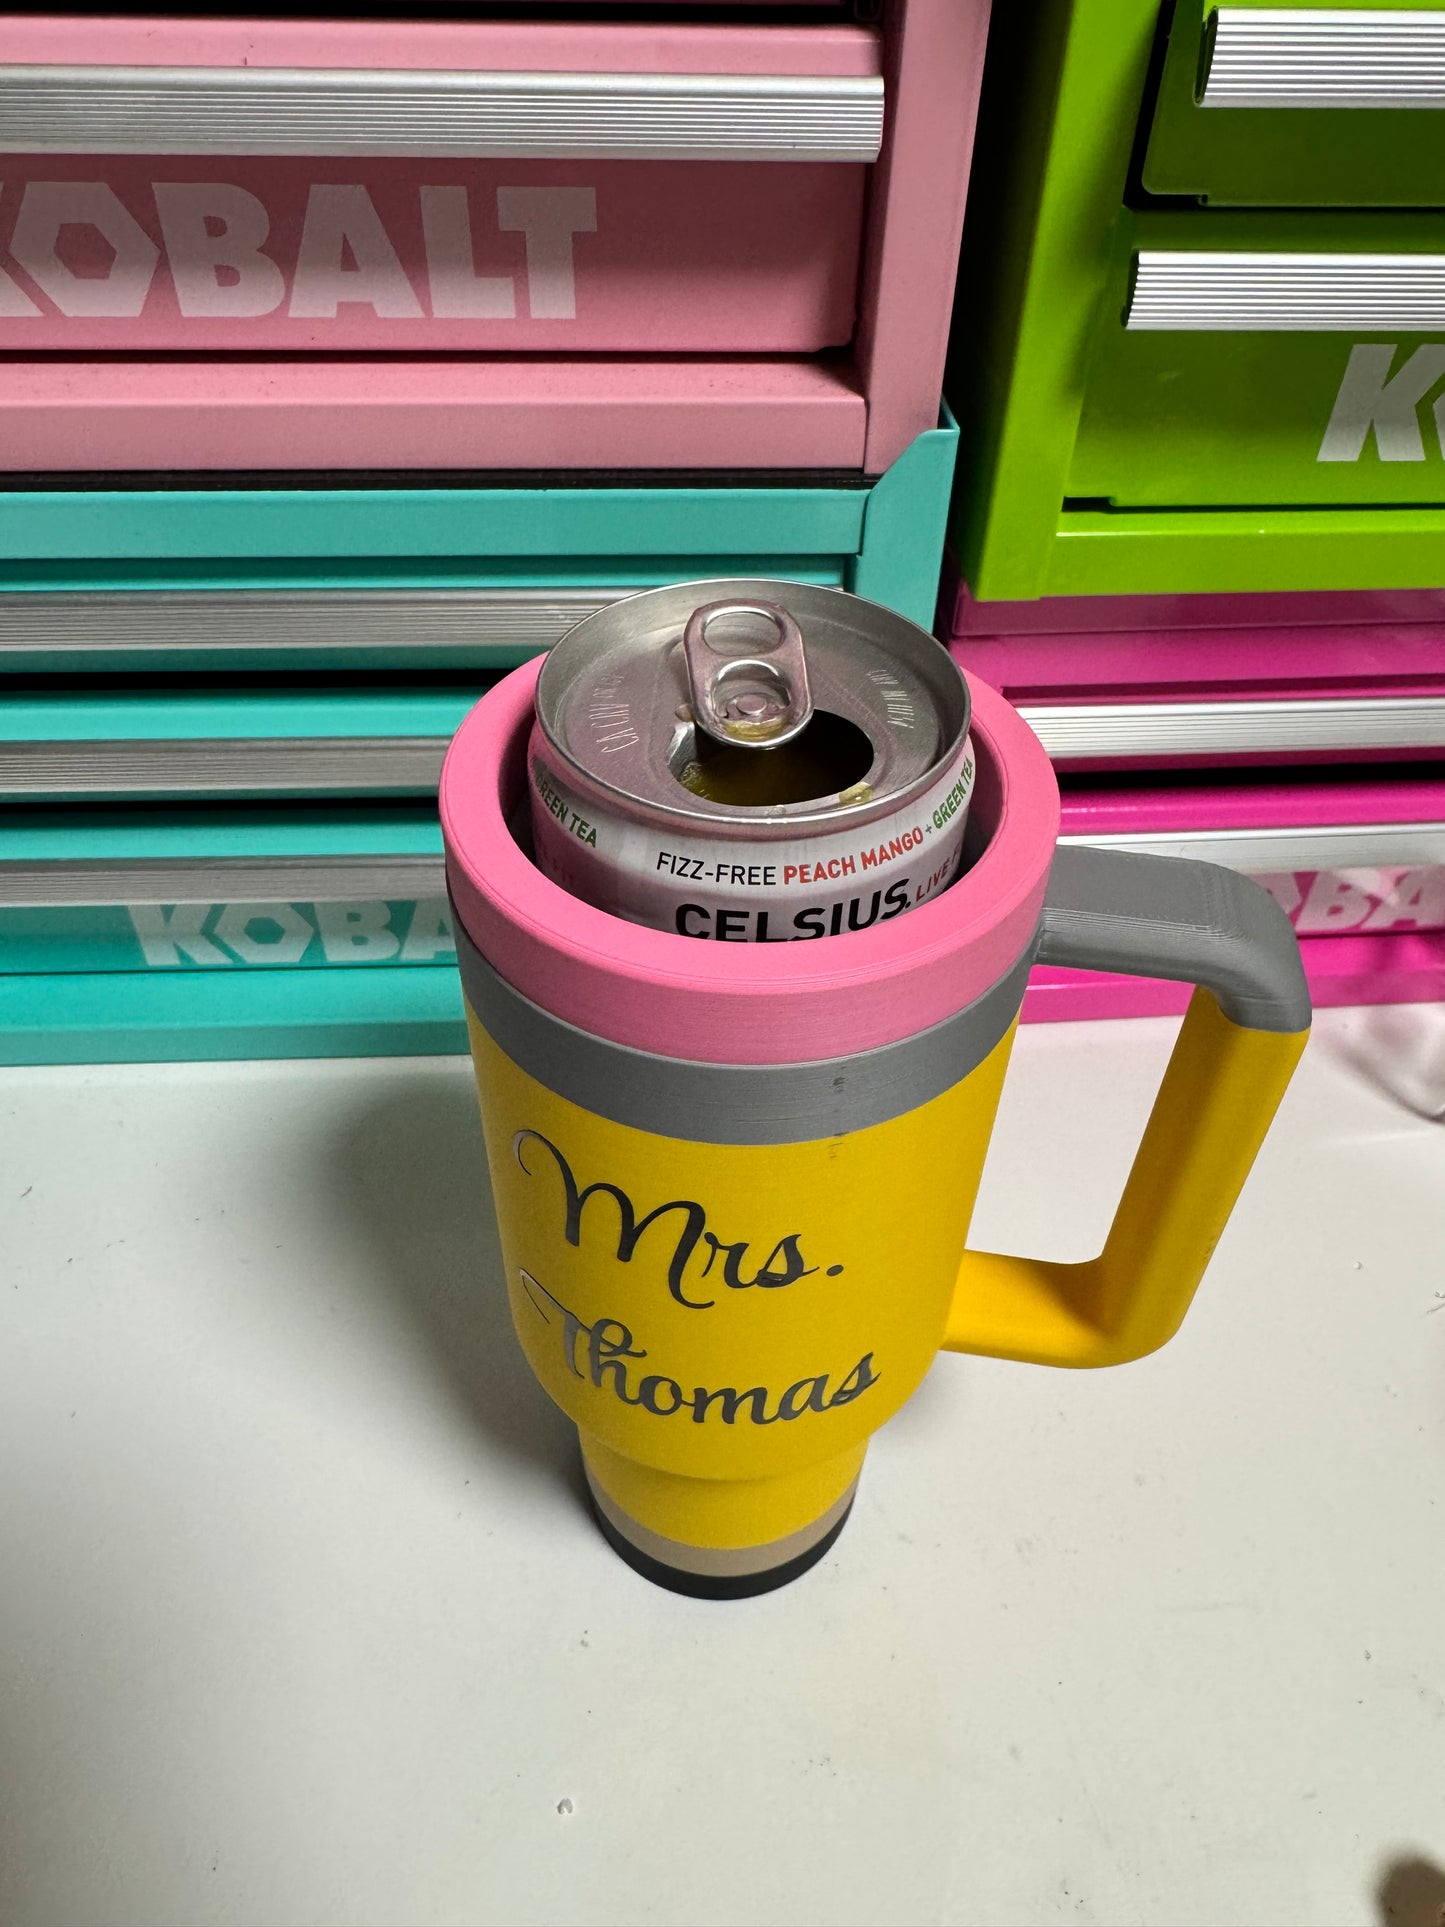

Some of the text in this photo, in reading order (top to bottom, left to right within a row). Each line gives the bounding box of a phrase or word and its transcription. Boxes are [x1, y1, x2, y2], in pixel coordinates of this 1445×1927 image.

[0, 181, 598, 320] OBALT
[569, 812, 597, 848] TEA
[656, 851, 777, 886] FIZZ-FREE
[783, 855, 857, 885] PEACH
[860, 826, 924, 871] MANGO
[932, 779, 967, 829] GREEN
[960, 754, 973, 785] TEA
[915, 859, 949, 902] LIVE
[512, 1129, 844, 1309] Mrs.
[519, 1267, 882, 1424] Thomas
